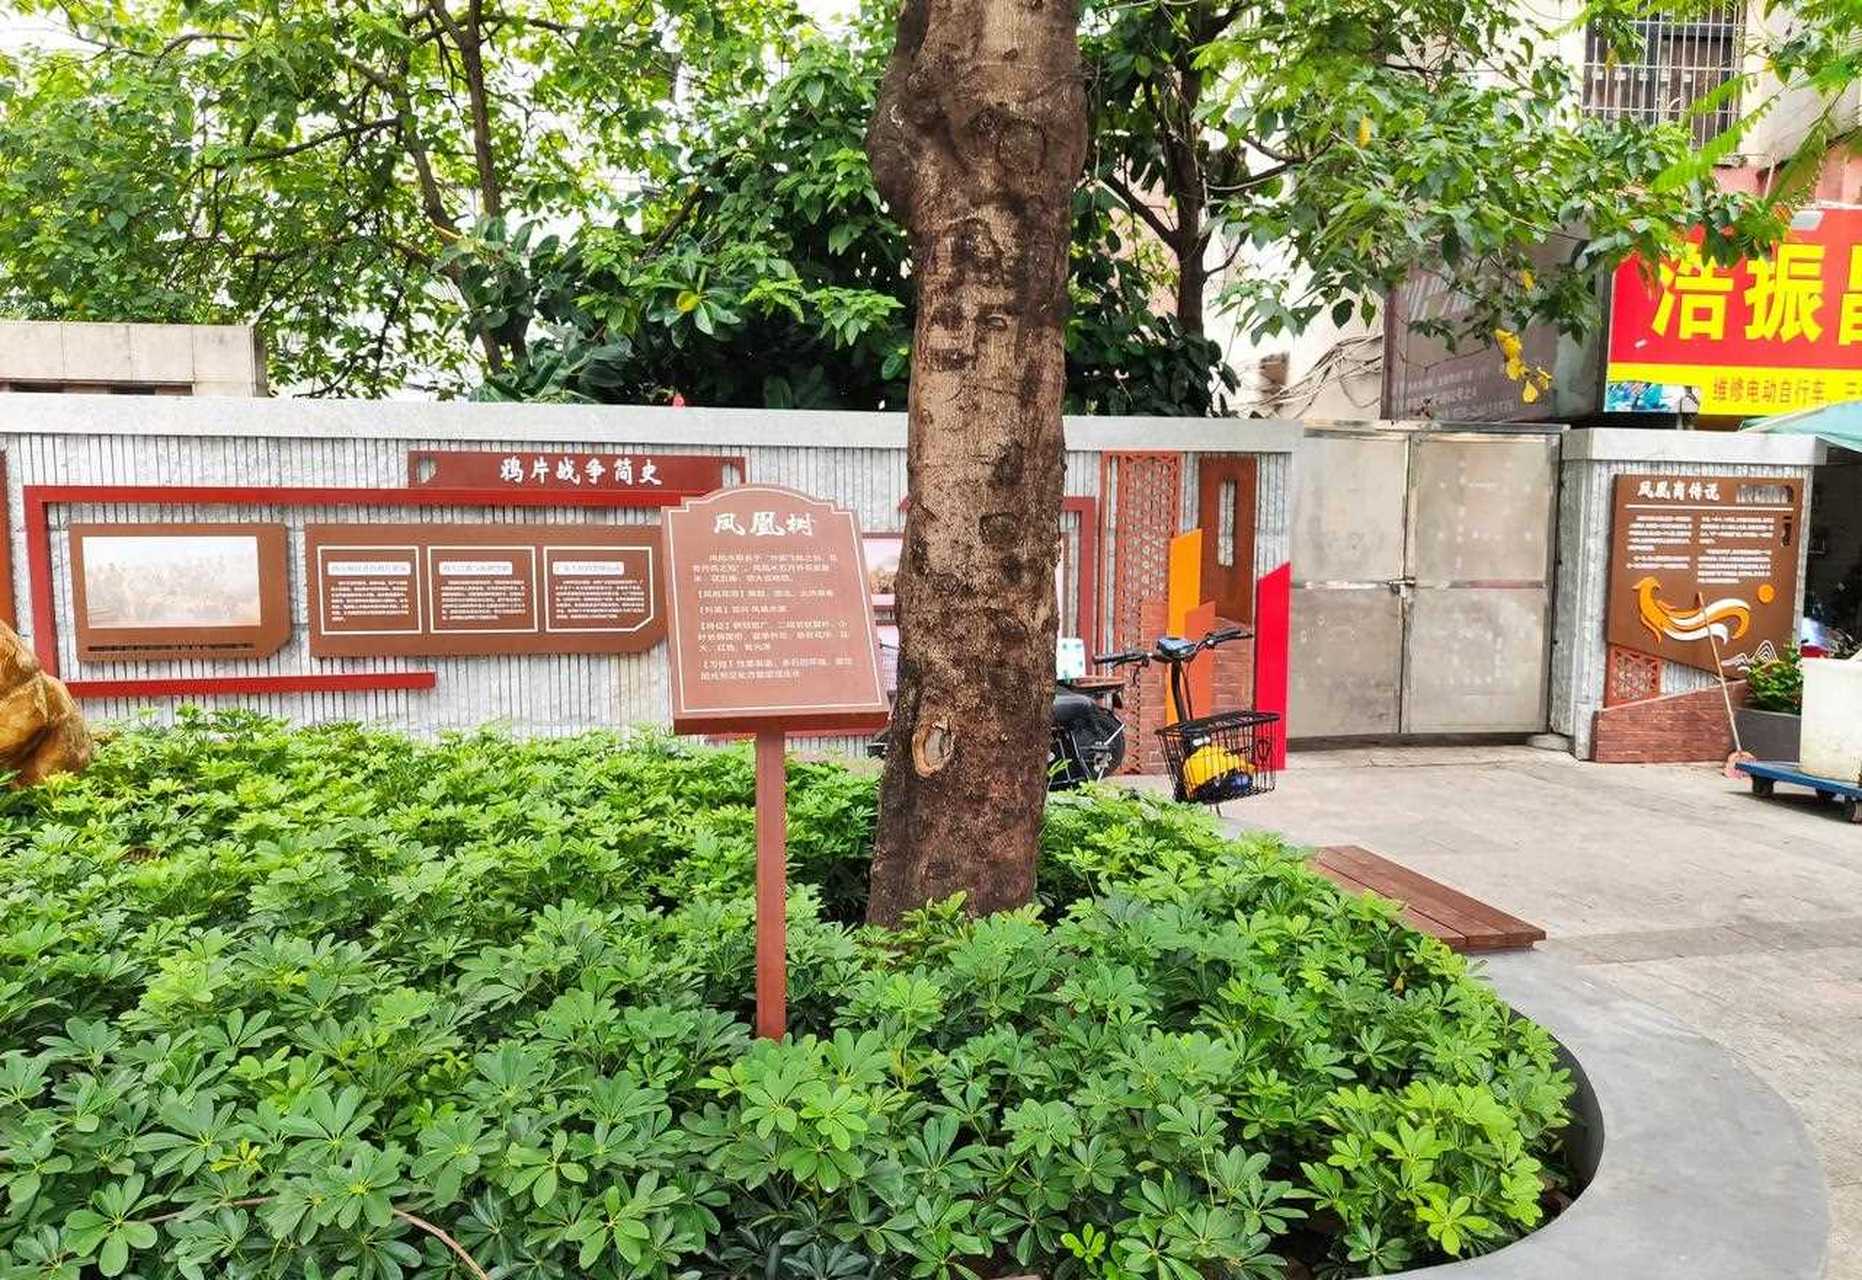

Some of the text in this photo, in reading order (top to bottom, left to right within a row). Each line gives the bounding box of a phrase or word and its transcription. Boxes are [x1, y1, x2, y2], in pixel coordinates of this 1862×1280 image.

[1651, 242, 1862, 345] 浩振
[1712, 376, 1825, 403] 维修电动自行车
[500, 455, 662, 485] 鸦片战争简史
[713, 511, 815, 537] 凤凰树
